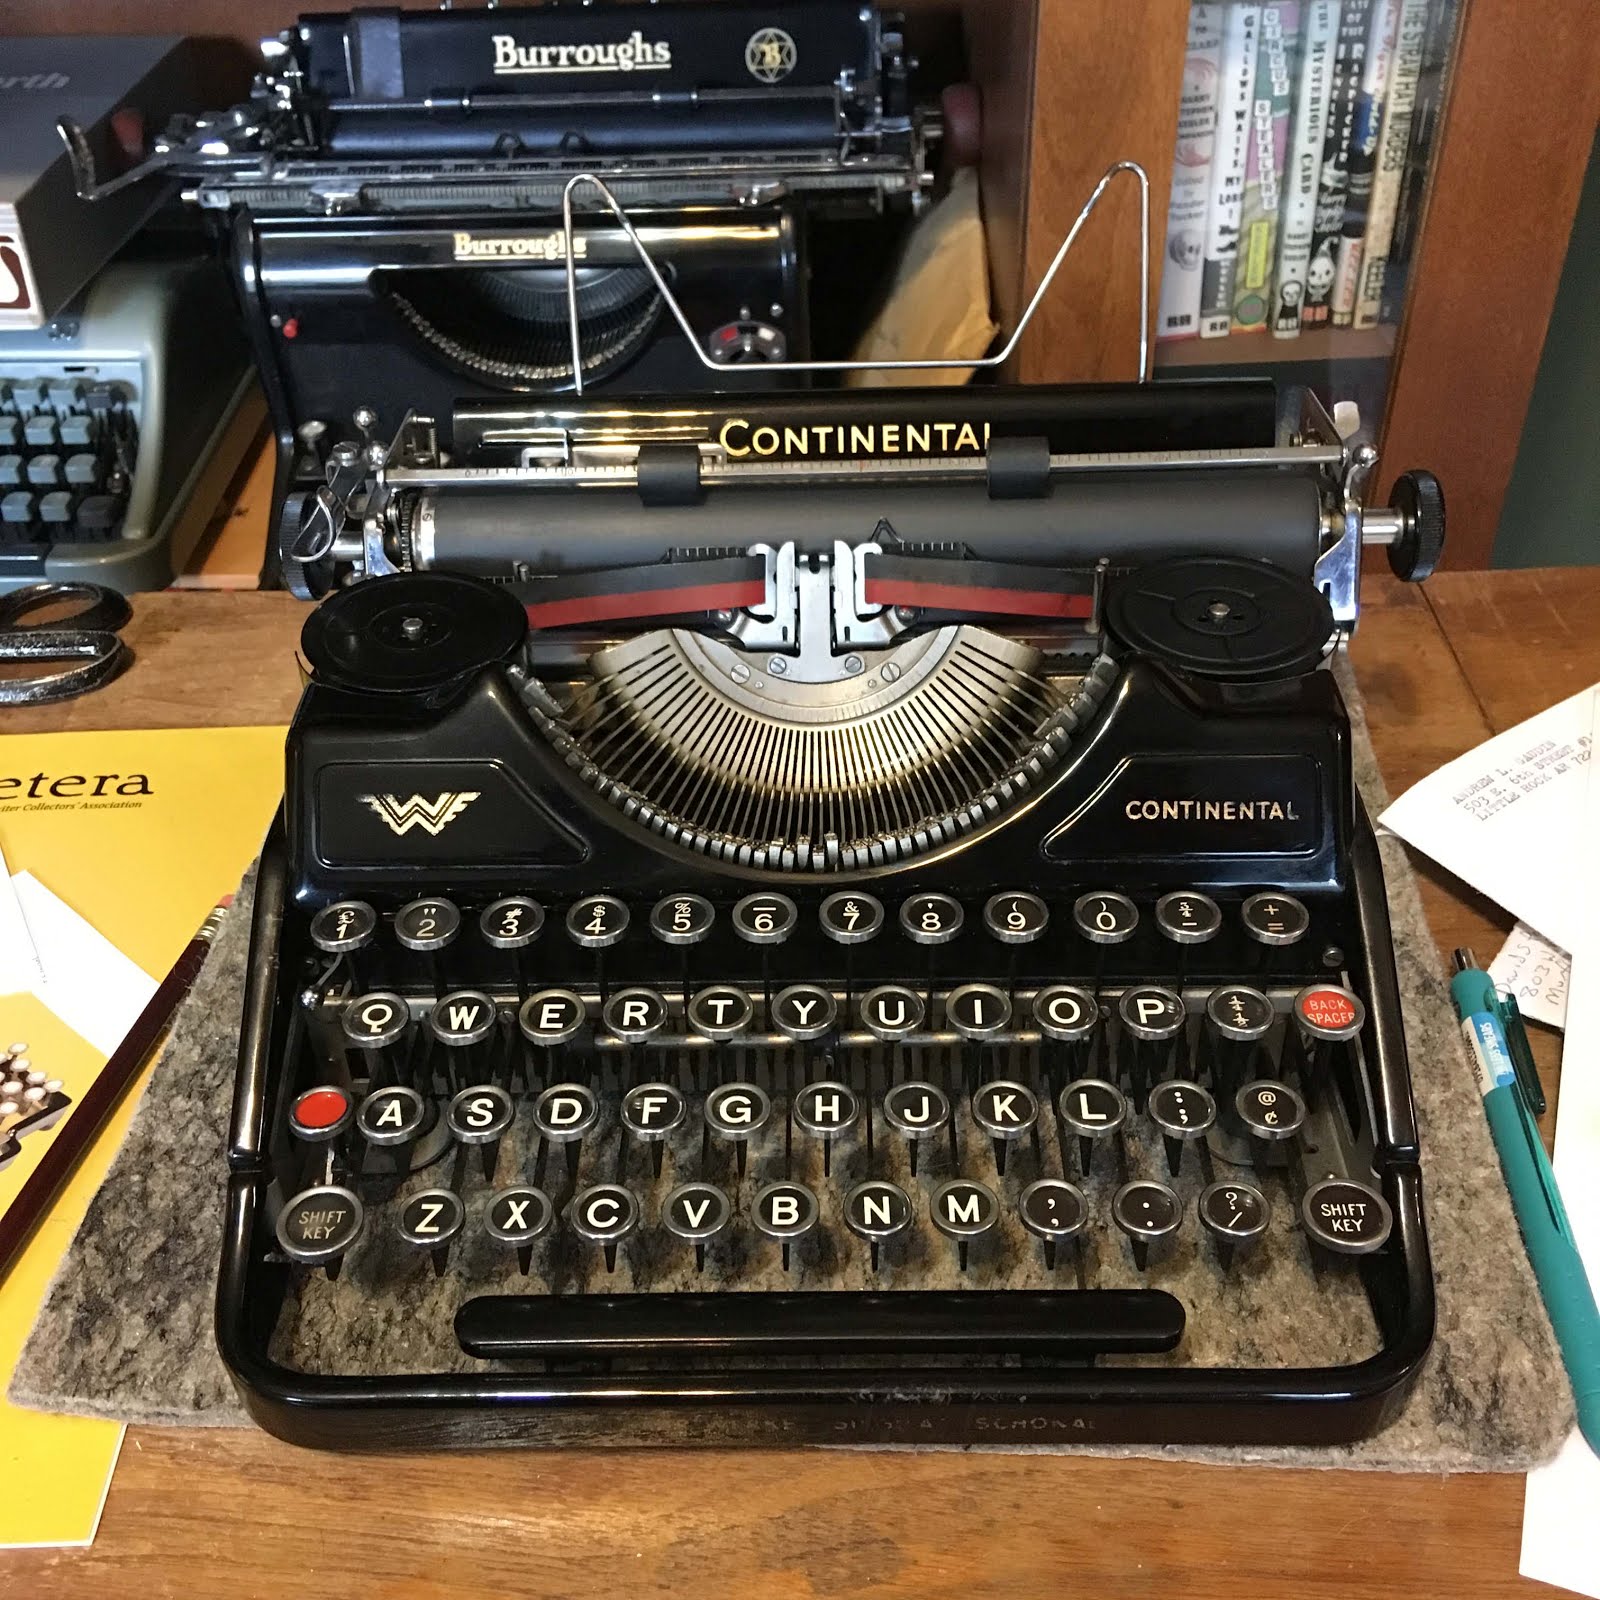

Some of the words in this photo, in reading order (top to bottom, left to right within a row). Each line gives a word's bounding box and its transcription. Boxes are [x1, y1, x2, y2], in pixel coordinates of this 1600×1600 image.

[492, 31, 671, 71] Burroughs
[1308, 41, 1326, 145] MYSTERIOUS
[1300, 153, 1314, 194] CARD
[1452, 775, 1495, 805] ANDREW
[1464, 796, 1490, 814] 503
[1509, 770, 1534, 785] 6th
[1476, 791, 1521, 822] LITTLE
[1520, 774, 1552, 794] ROCK
[81, 801, 142, 810] Association
[1125, 800, 1299, 821] CONTINENTAL
[592, 904, 606, 917] $
[674, 902, 691, 914] %
[844, 901, 859, 913] &
[335, 924, 348, 939] 1
[416, 919, 436, 937] 2
[499, 919, 519, 936] 3
[584, 918, 606, 935] 4
[672, 914, 691, 931] 5
[754, 912, 774, 931] 6
[842, 912, 860, 931] 7
[921, 912, 941, 931] 8
[1006, 912, 1026, 930] 9
[1096, 912, 1116, 931] 0
[1520, 965, 1550, 998] 803
[361, 1003, 393, 1033] Q
[449, 1005, 479, 1030] W
[539, 1003, 566, 1029] E
[622, 1000, 647, 1027] R
[707, 999, 734, 1025] T
[791, 1000, 817, 1025] Y
[878, 1000, 905, 1026] U
[974, 999, 983, 1025] I
[1048, 997, 1081, 1025] O
[1136, 998, 1165, 1024] P
[1309, 999, 1348, 1011] BACK
[550, 1097, 582, 1125] D
[641, 1097, 668, 1125] F
[718, 1095, 751, 1123] G
[814, 1094, 840, 1122] H
[903, 1095, 930, 1123] J
[992, 1094, 1020, 1122] K
[1080, 1093, 1107, 1121] L
[1257, 1091, 1276, 1106] @
[376, 1099, 403, 1127] A
[466, 1097, 494, 1127] S
[586, 1198, 619, 1228] C
[682, 1199, 711, 1229] V
[771, 1196, 800, 1225] B
[862, 1196, 891, 1225] N
[946, 1194, 980, 1223] M
[1225, 1192, 1238, 1211] ?
[1320, 1203, 1367, 1217] SHIFT
[299, 1210, 347, 1224] SHIFT
[414, 1203, 444, 1233] Z
[502, 1200, 530, 1230] X
[1331, 1219, 1364, 1233] KEY
[302, 1226, 337, 1240] KEY
